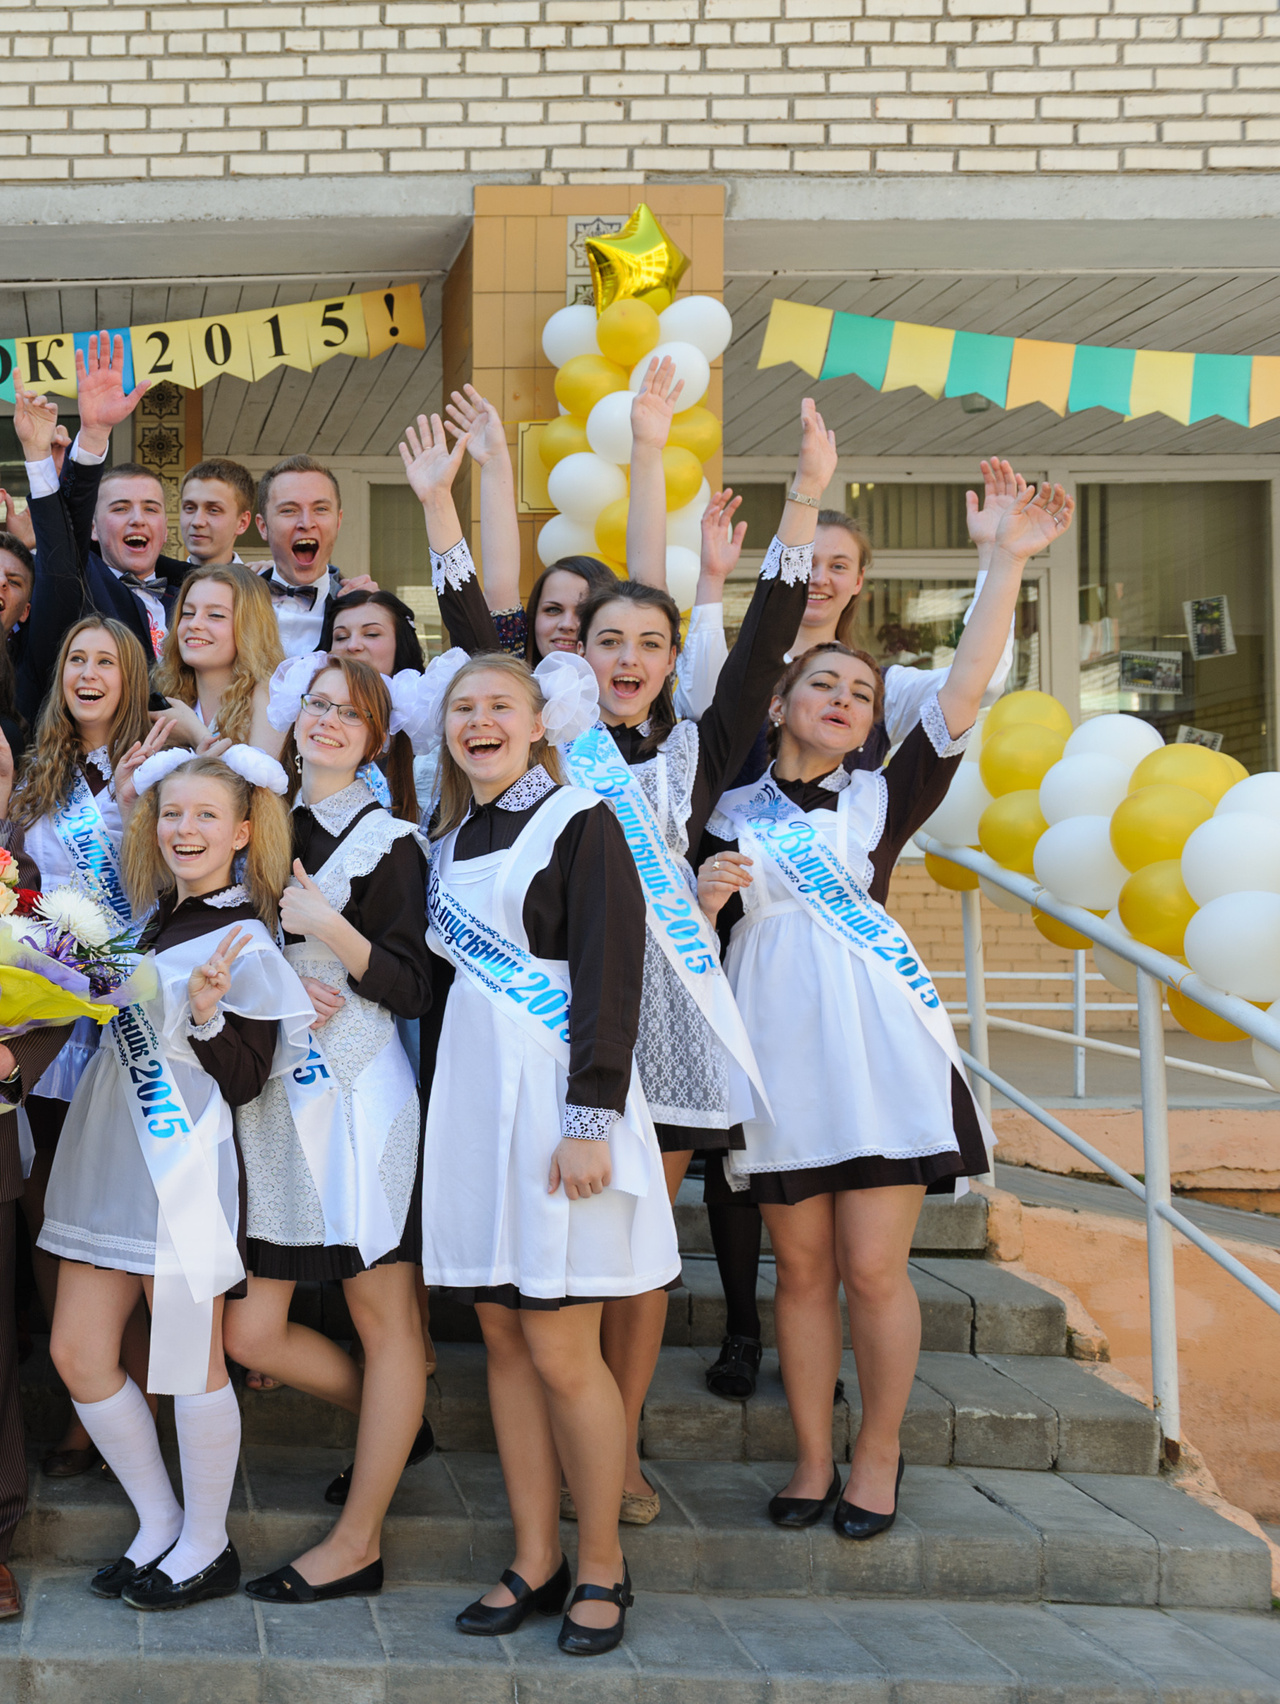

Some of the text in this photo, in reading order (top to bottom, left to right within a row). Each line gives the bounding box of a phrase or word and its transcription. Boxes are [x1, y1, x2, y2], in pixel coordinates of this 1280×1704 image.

[144, 292, 399, 376] 2015!
[426, 870, 525, 984] Выпускник
[651, 898, 717, 975] 2015
[767, 820, 940, 1010] Выпускник 2015
[129, 1059, 191, 1139] 2015
